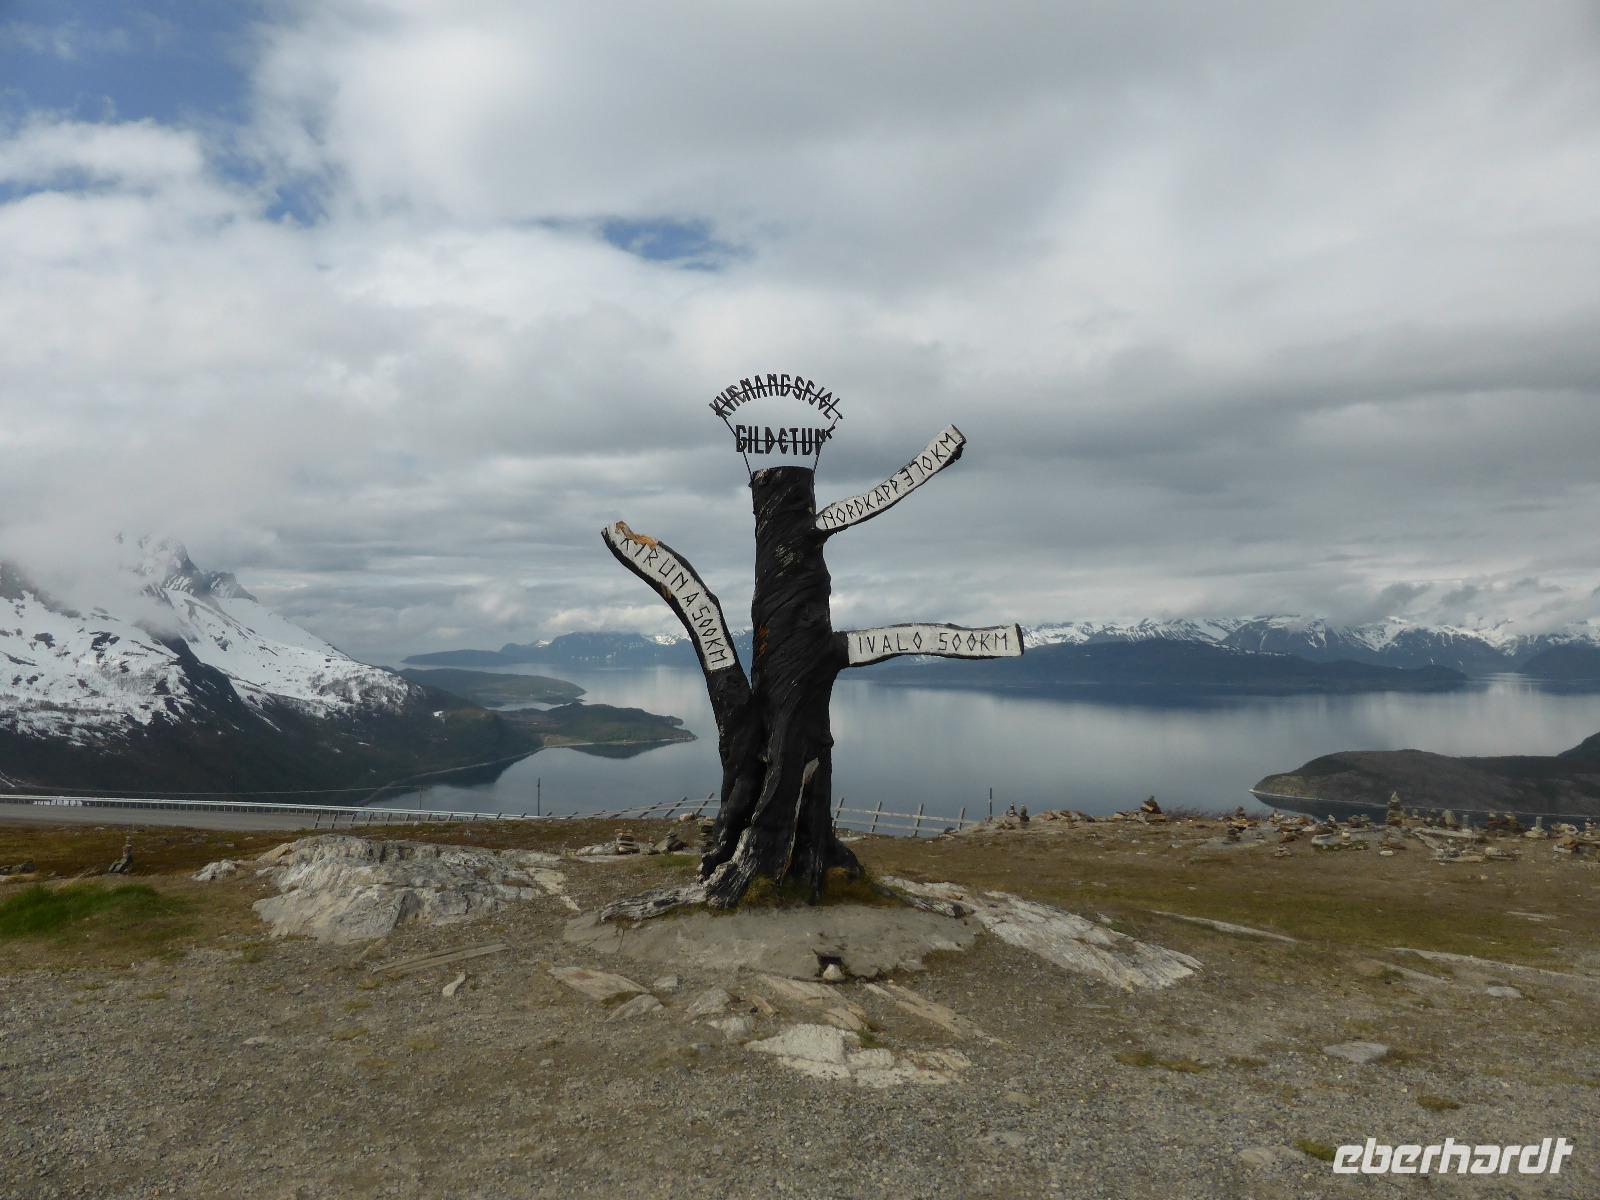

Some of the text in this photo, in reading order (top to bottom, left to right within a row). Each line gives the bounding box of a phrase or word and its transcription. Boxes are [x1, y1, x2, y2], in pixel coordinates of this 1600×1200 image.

[735, 424, 826, 456] GILDETUN
[821, 478, 899, 529] NORDKAPP
[619, 537, 728, 664] KIRUNA 500KM
[858, 631, 1009, 655] IVALO 500KM
